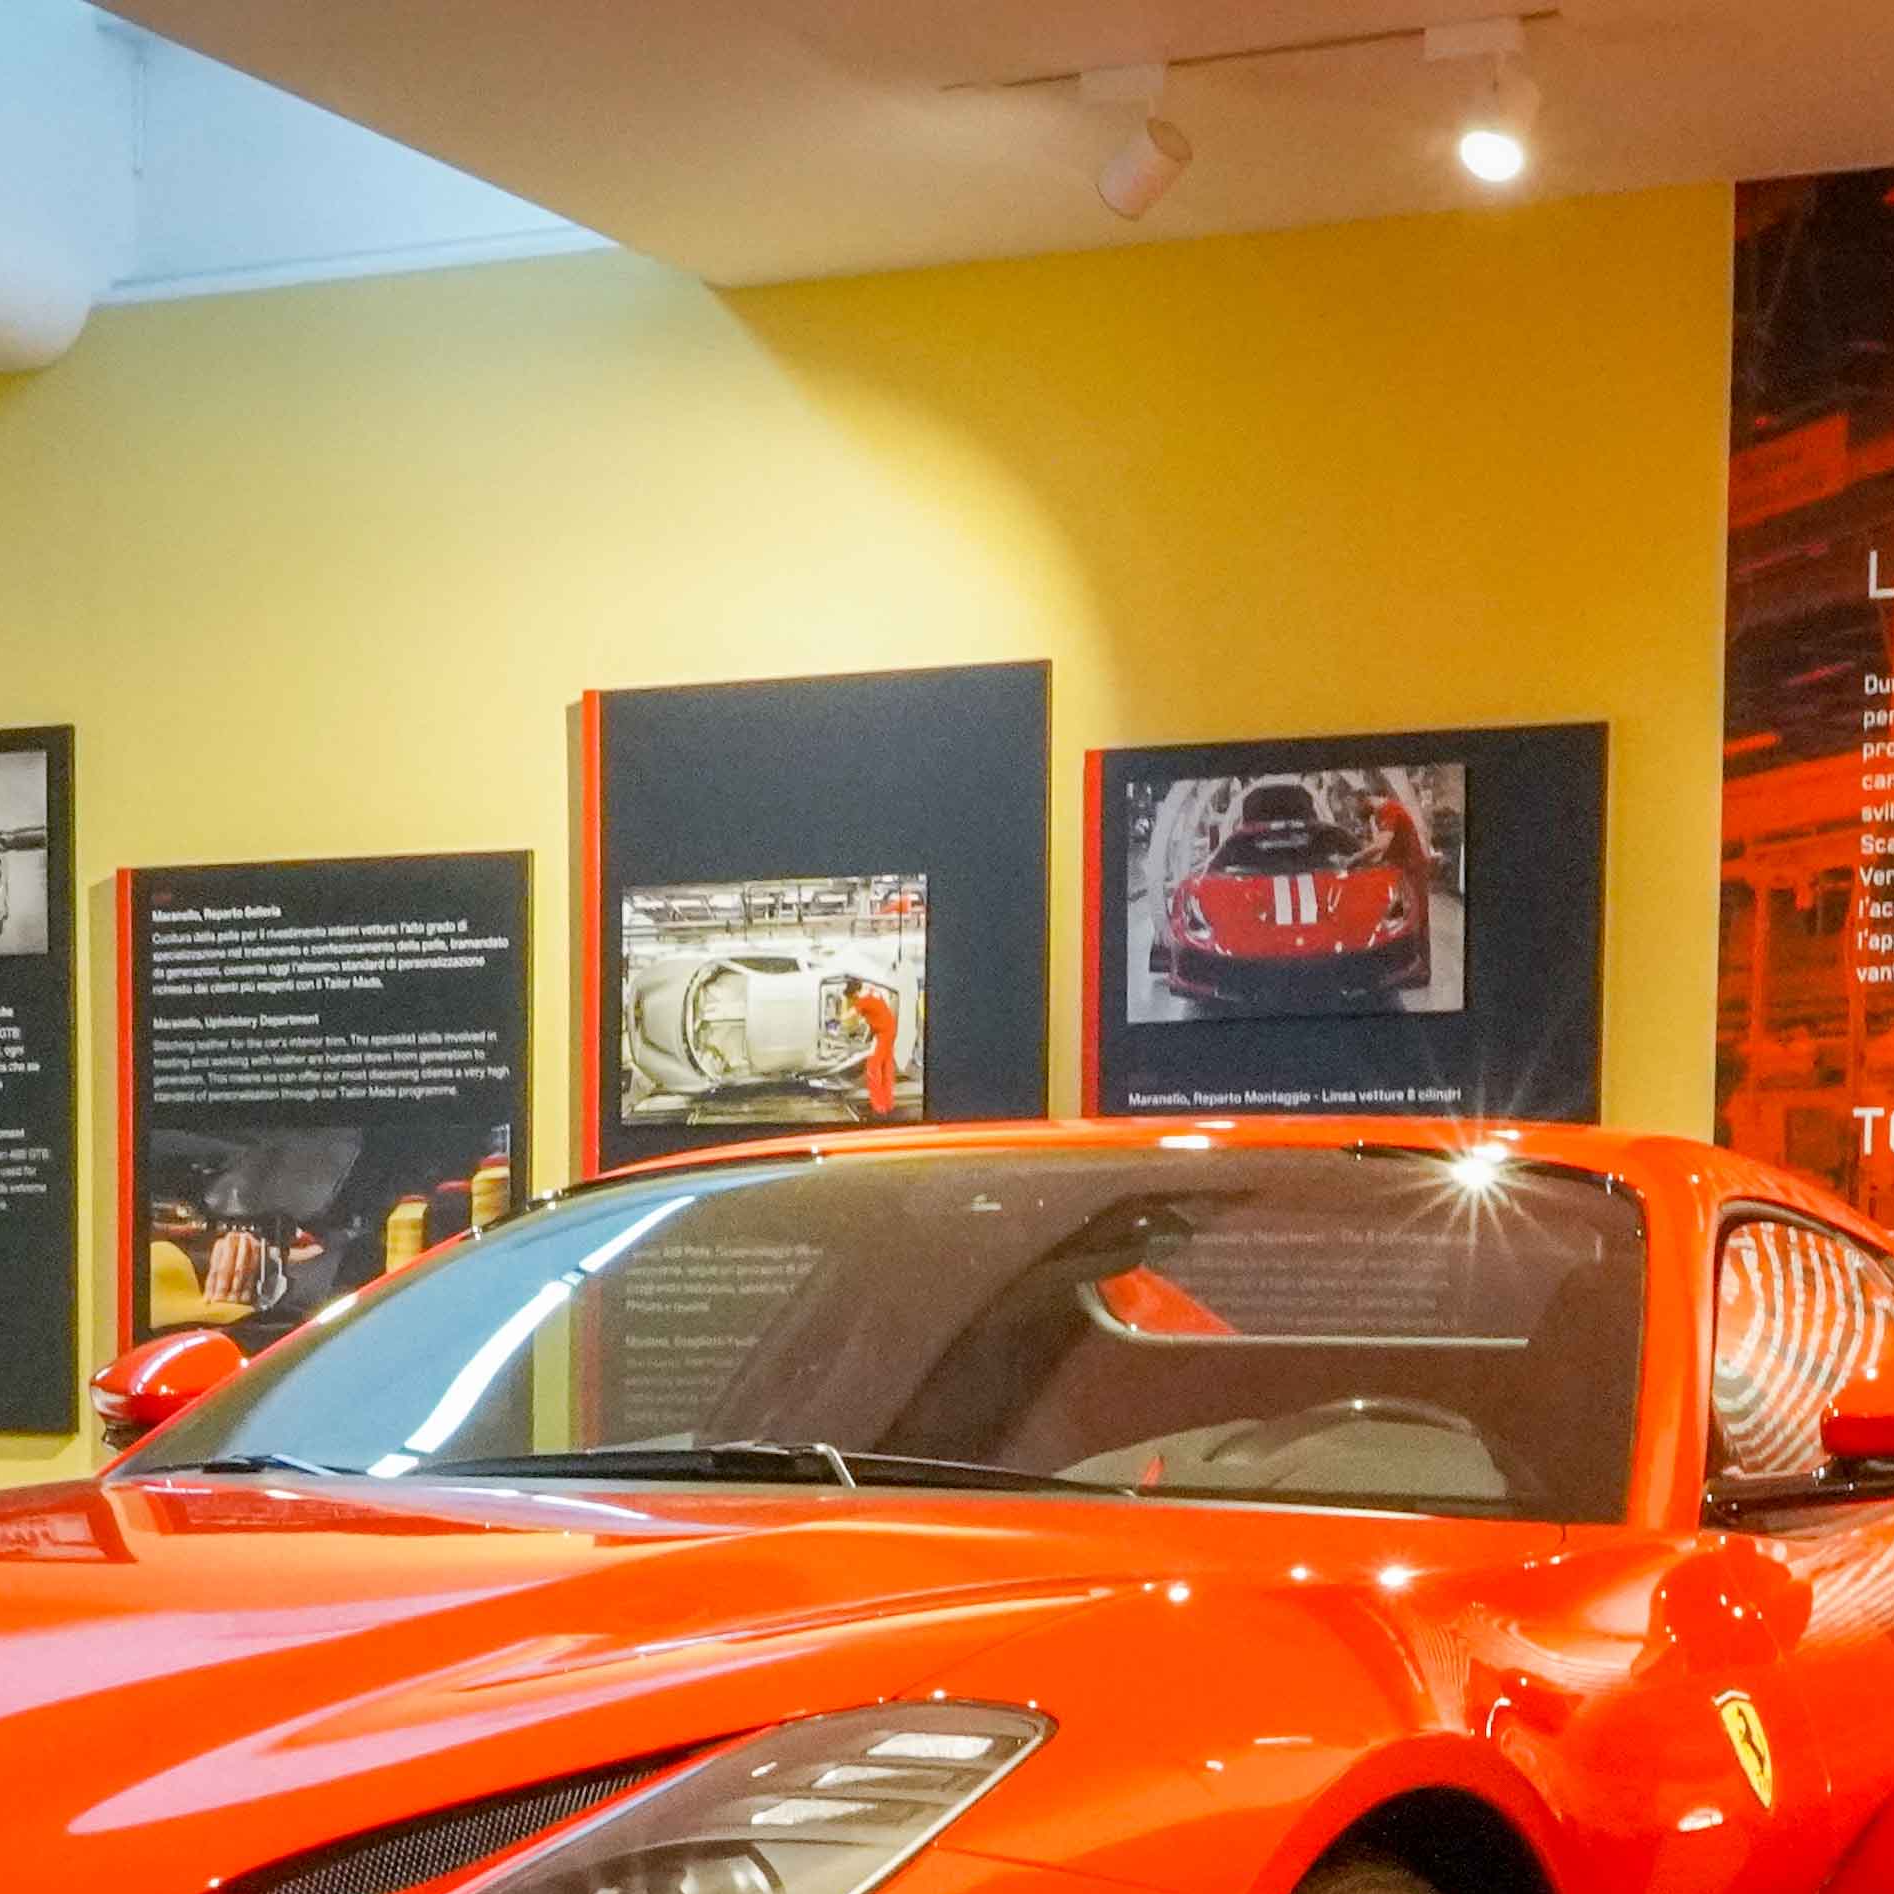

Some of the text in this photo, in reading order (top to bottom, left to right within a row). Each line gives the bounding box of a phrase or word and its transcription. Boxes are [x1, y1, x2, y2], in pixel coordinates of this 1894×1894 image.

[1193, 1092, 1241, 1106] Reparto
[1244, 1091, 1310, 1105] Montaggio
[1359, 1090, 1403, 1102] vetture
